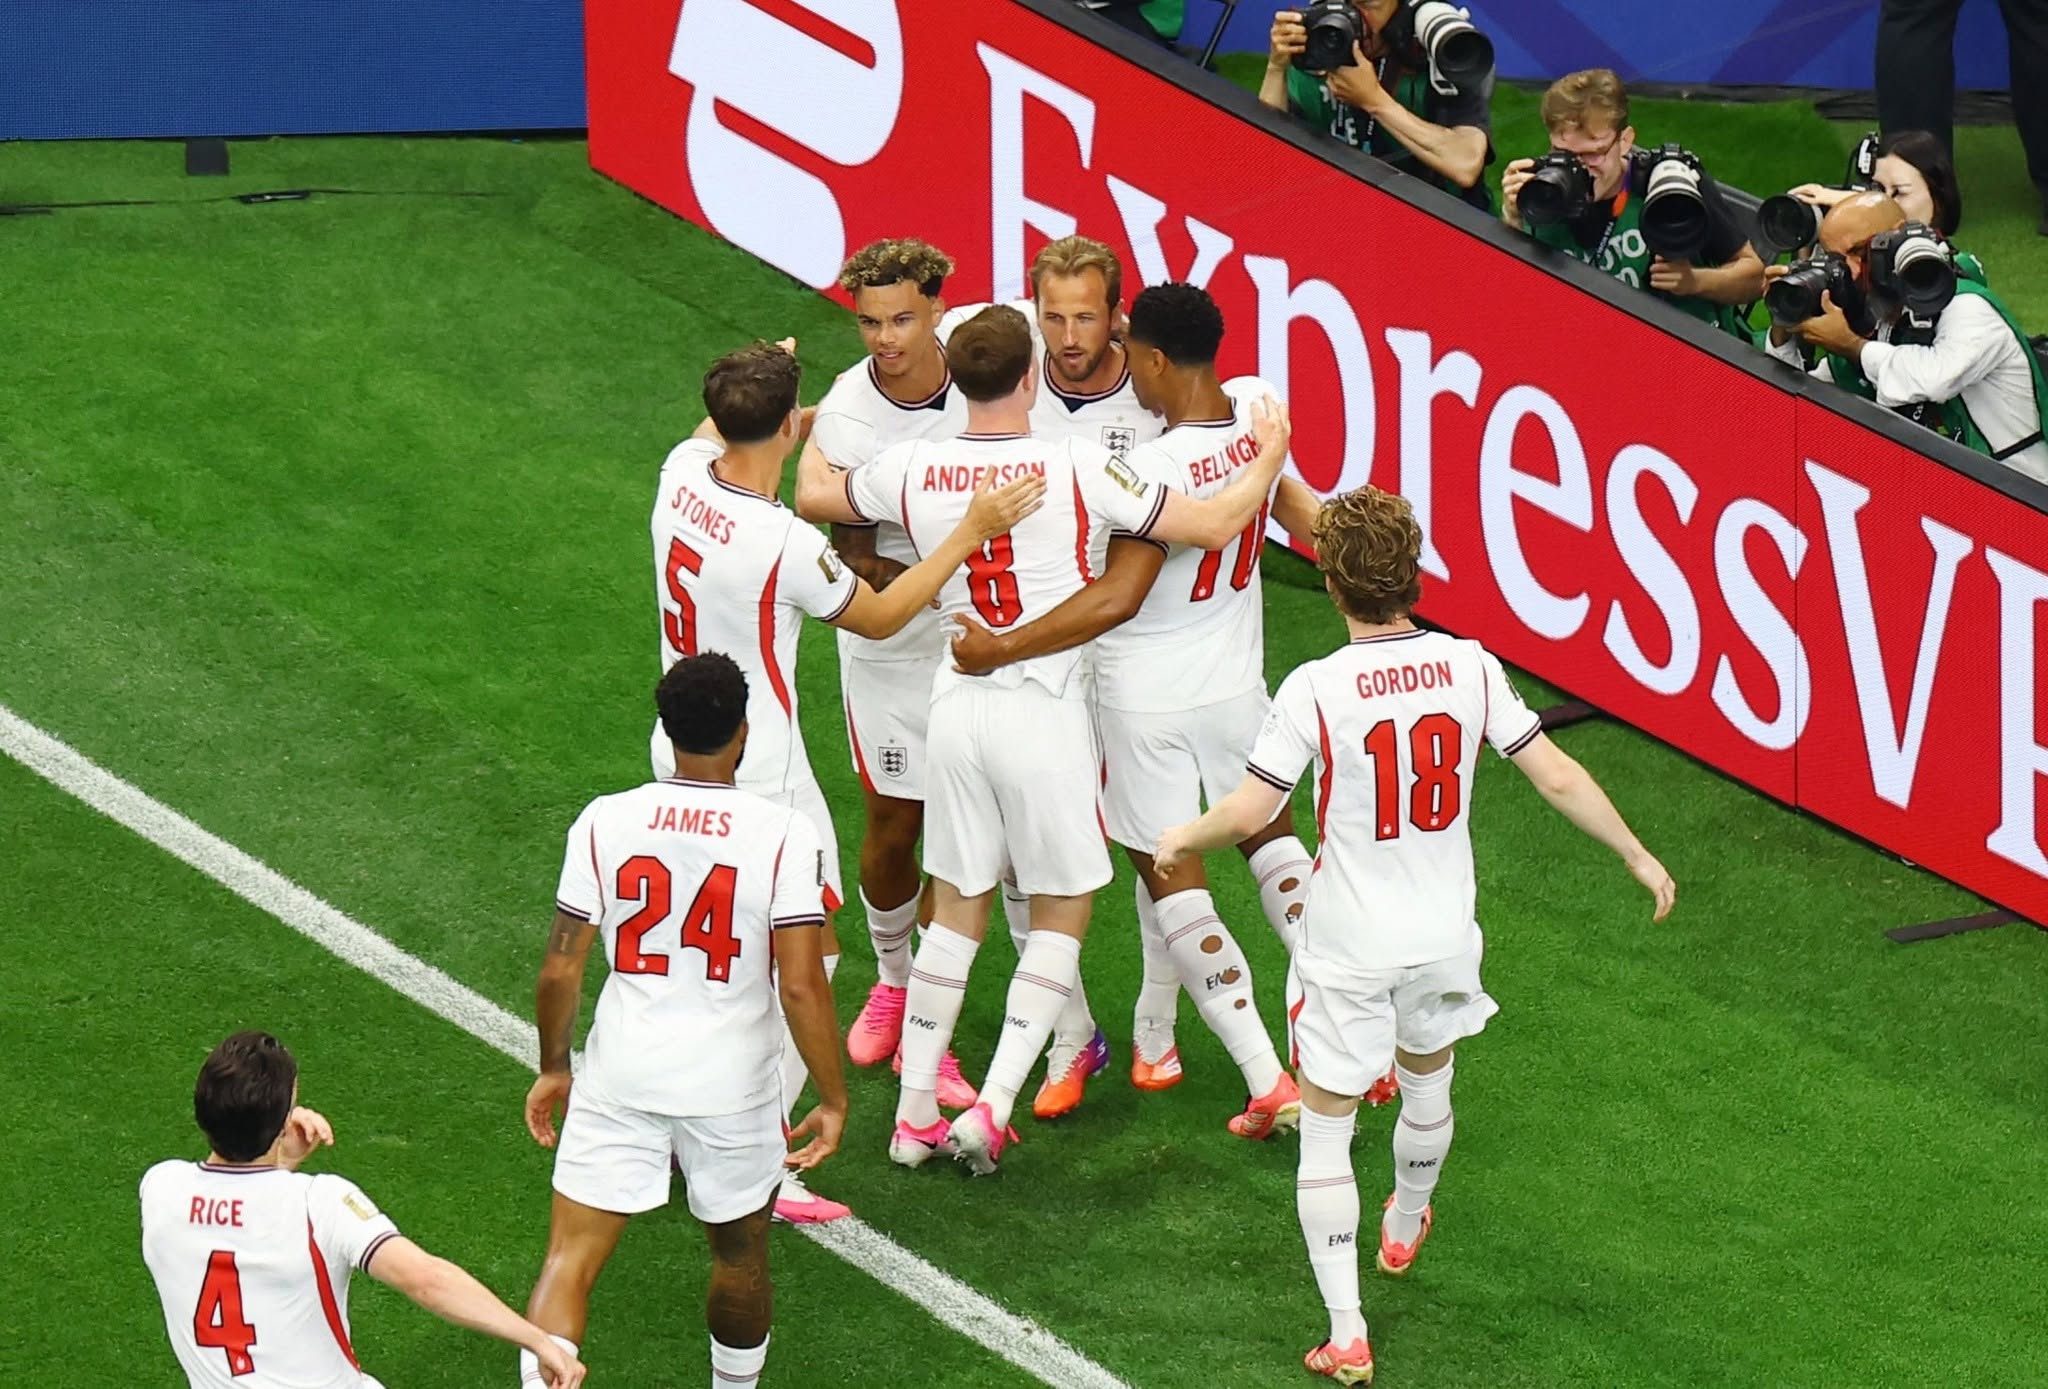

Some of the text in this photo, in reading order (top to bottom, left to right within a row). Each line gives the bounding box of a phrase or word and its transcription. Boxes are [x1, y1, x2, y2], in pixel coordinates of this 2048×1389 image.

[671, 485, 736, 545] STONES
[663, 535, 704, 658] 5
[965, 527, 1024, 627] 8
[1356, 661, 1453, 700] GORDON
[1363, 712, 1463, 843] 18
[648, 805, 732, 838] JAMES
[614, 855, 742, 984] 24
[909, 1015, 937, 1030] ENG
[1005, 1015, 1030, 1029] ENG
[1408, 1157, 1438, 1169] ENG
[189, 1195, 244, 1229] RICE
[1327, 1232, 1353, 1247] ENG
[193, 1249, 257, 1377] 4
